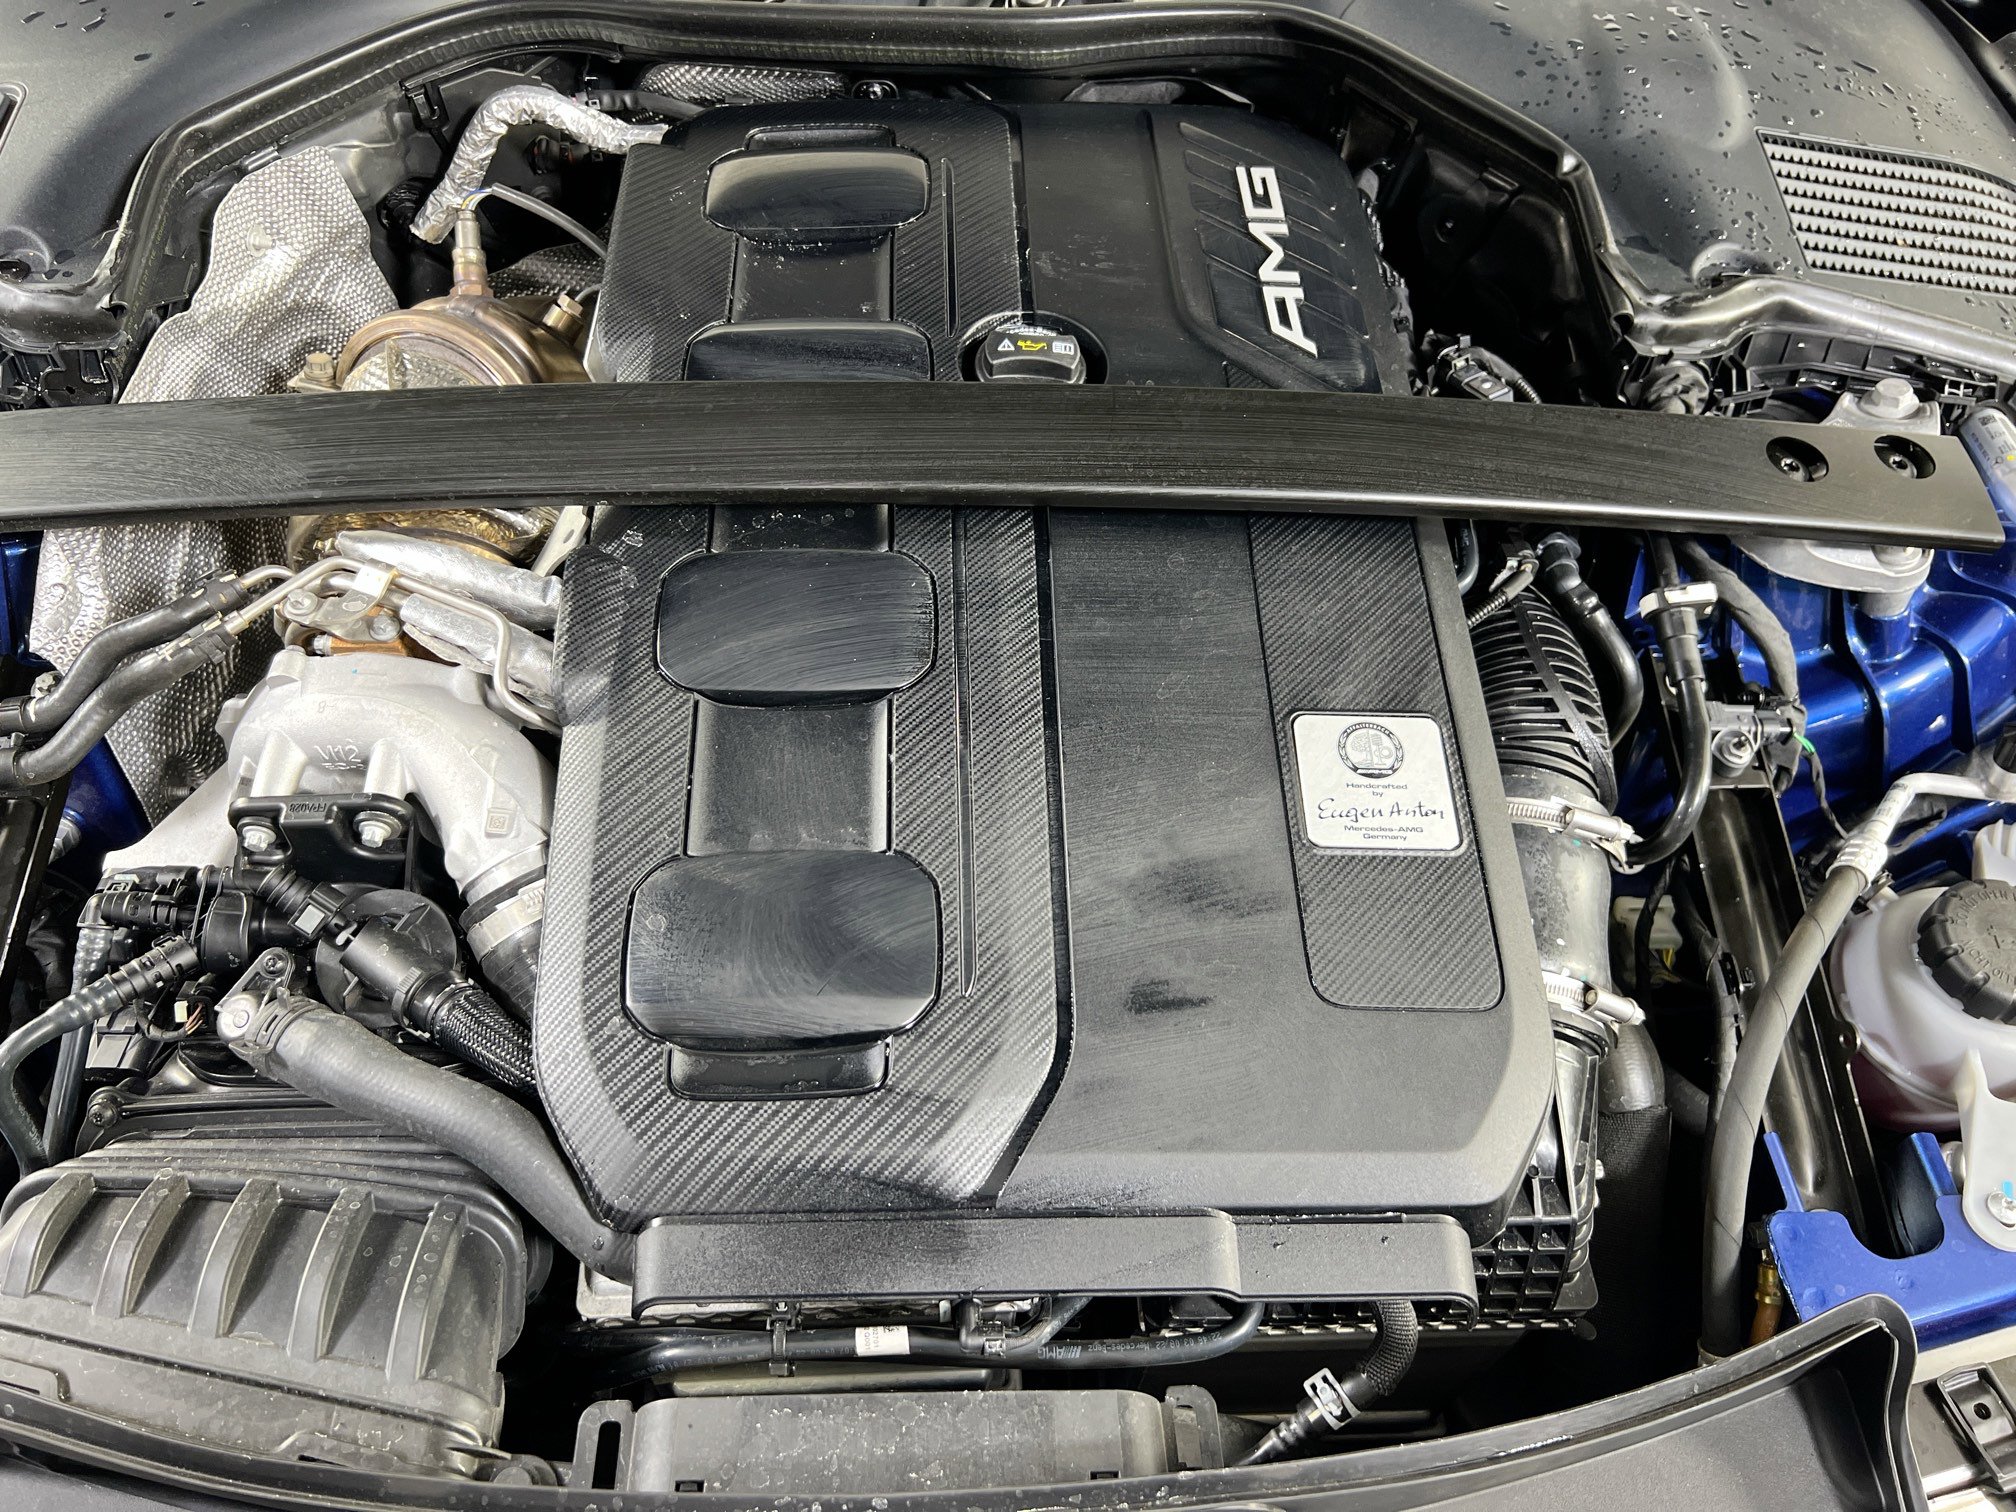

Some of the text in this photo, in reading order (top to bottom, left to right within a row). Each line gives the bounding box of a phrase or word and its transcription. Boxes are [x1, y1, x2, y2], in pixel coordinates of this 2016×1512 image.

[1235, 166, 1318, 359] AMG
[1346, 782, 1408, 790] Handcrafted
[1317, 797, 1445, 823] Eugen Anton
[1344, 825, 1424, 833] Mercedes-AMG
[1363, 833, 1408, 841] Germany
[1087, 1341, 1150, 1353] Mercedes-Benz
